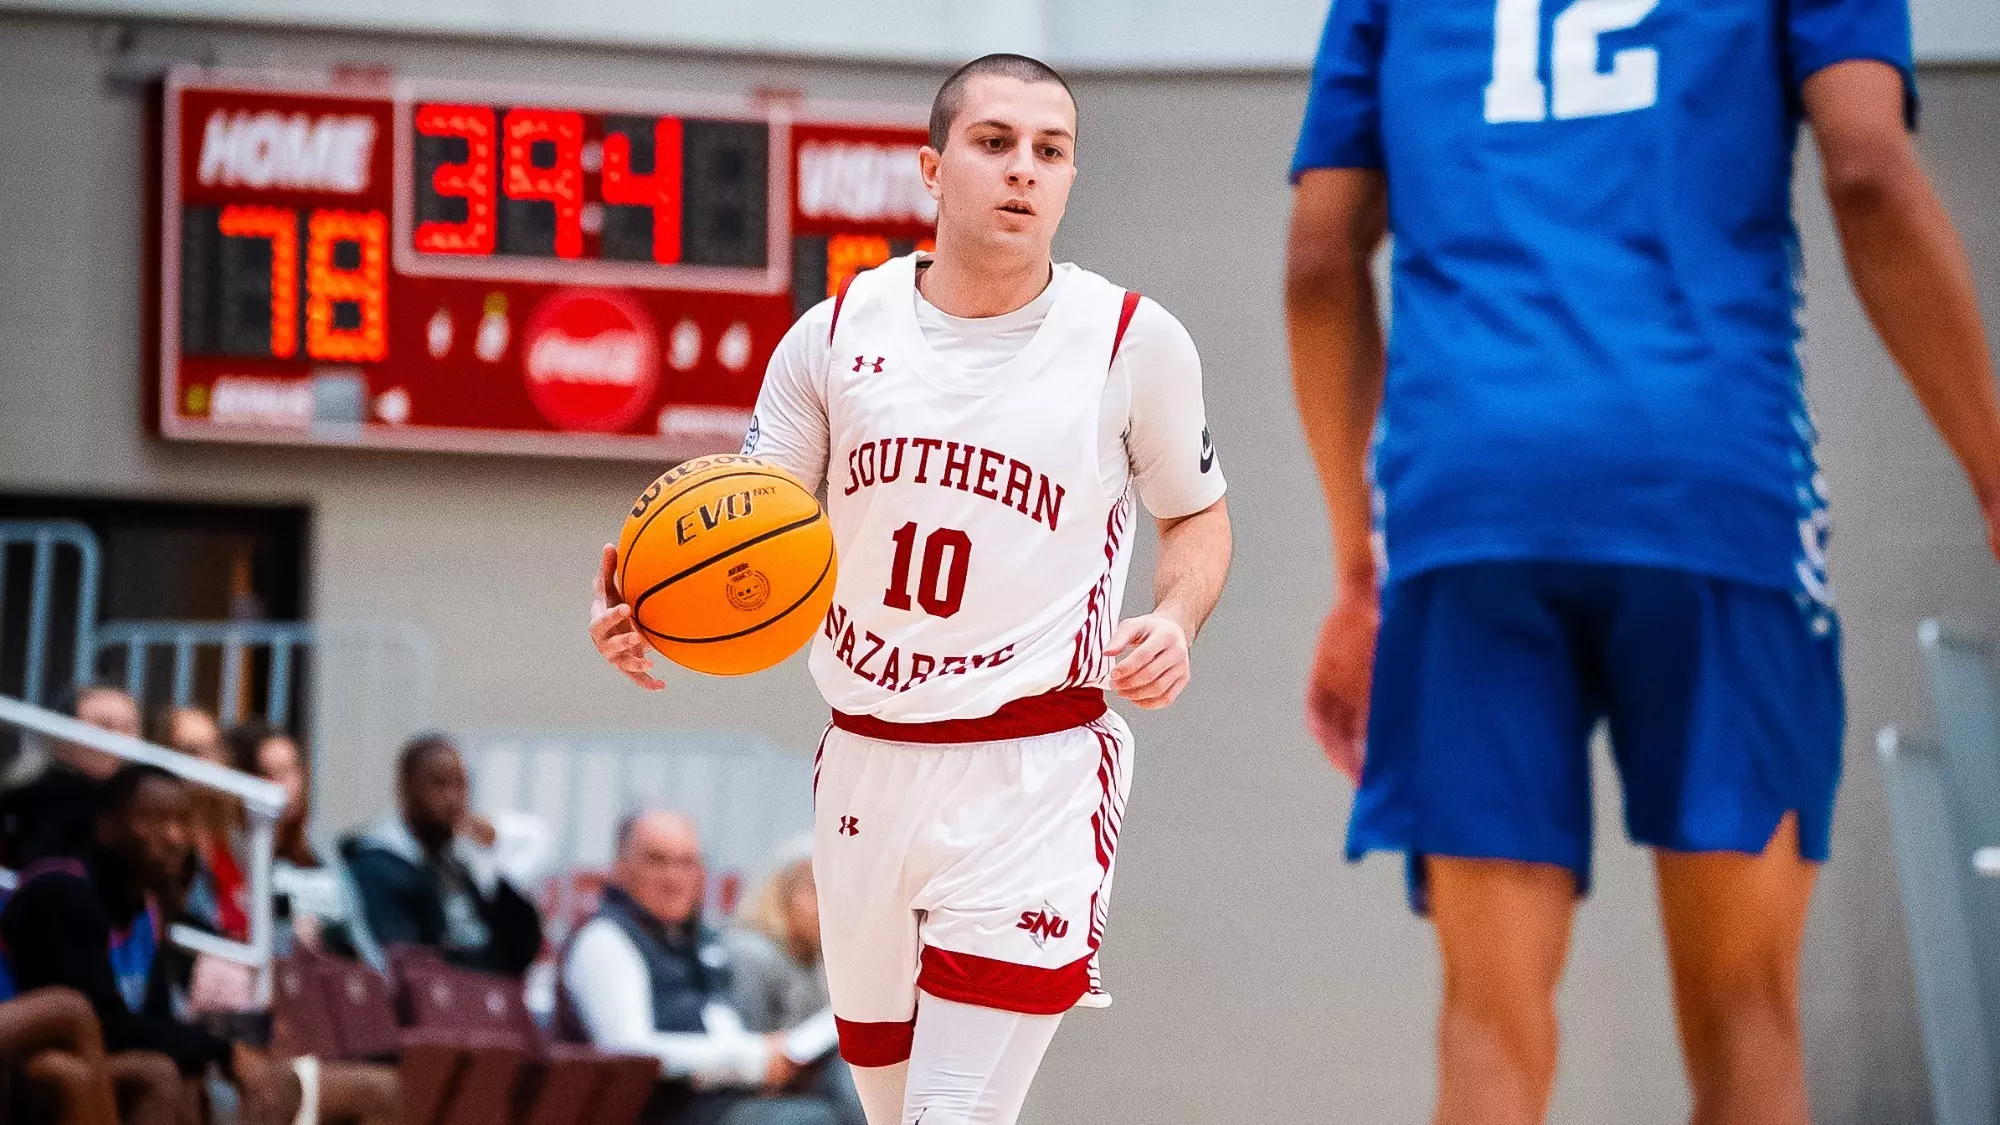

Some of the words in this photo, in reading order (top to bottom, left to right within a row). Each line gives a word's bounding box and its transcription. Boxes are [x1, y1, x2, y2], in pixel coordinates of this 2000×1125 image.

[1484, 0, 1658, 123] 12
[199, 108, 380, 194] HOME
[218, 205, 387, 361] 78
[676, 491, 752, 546] EVO
[844, 437, 1066, 532] SOUTHERN
[883, 521, 972, 619] 10
[1016, 909, 1069, 941] SNU
